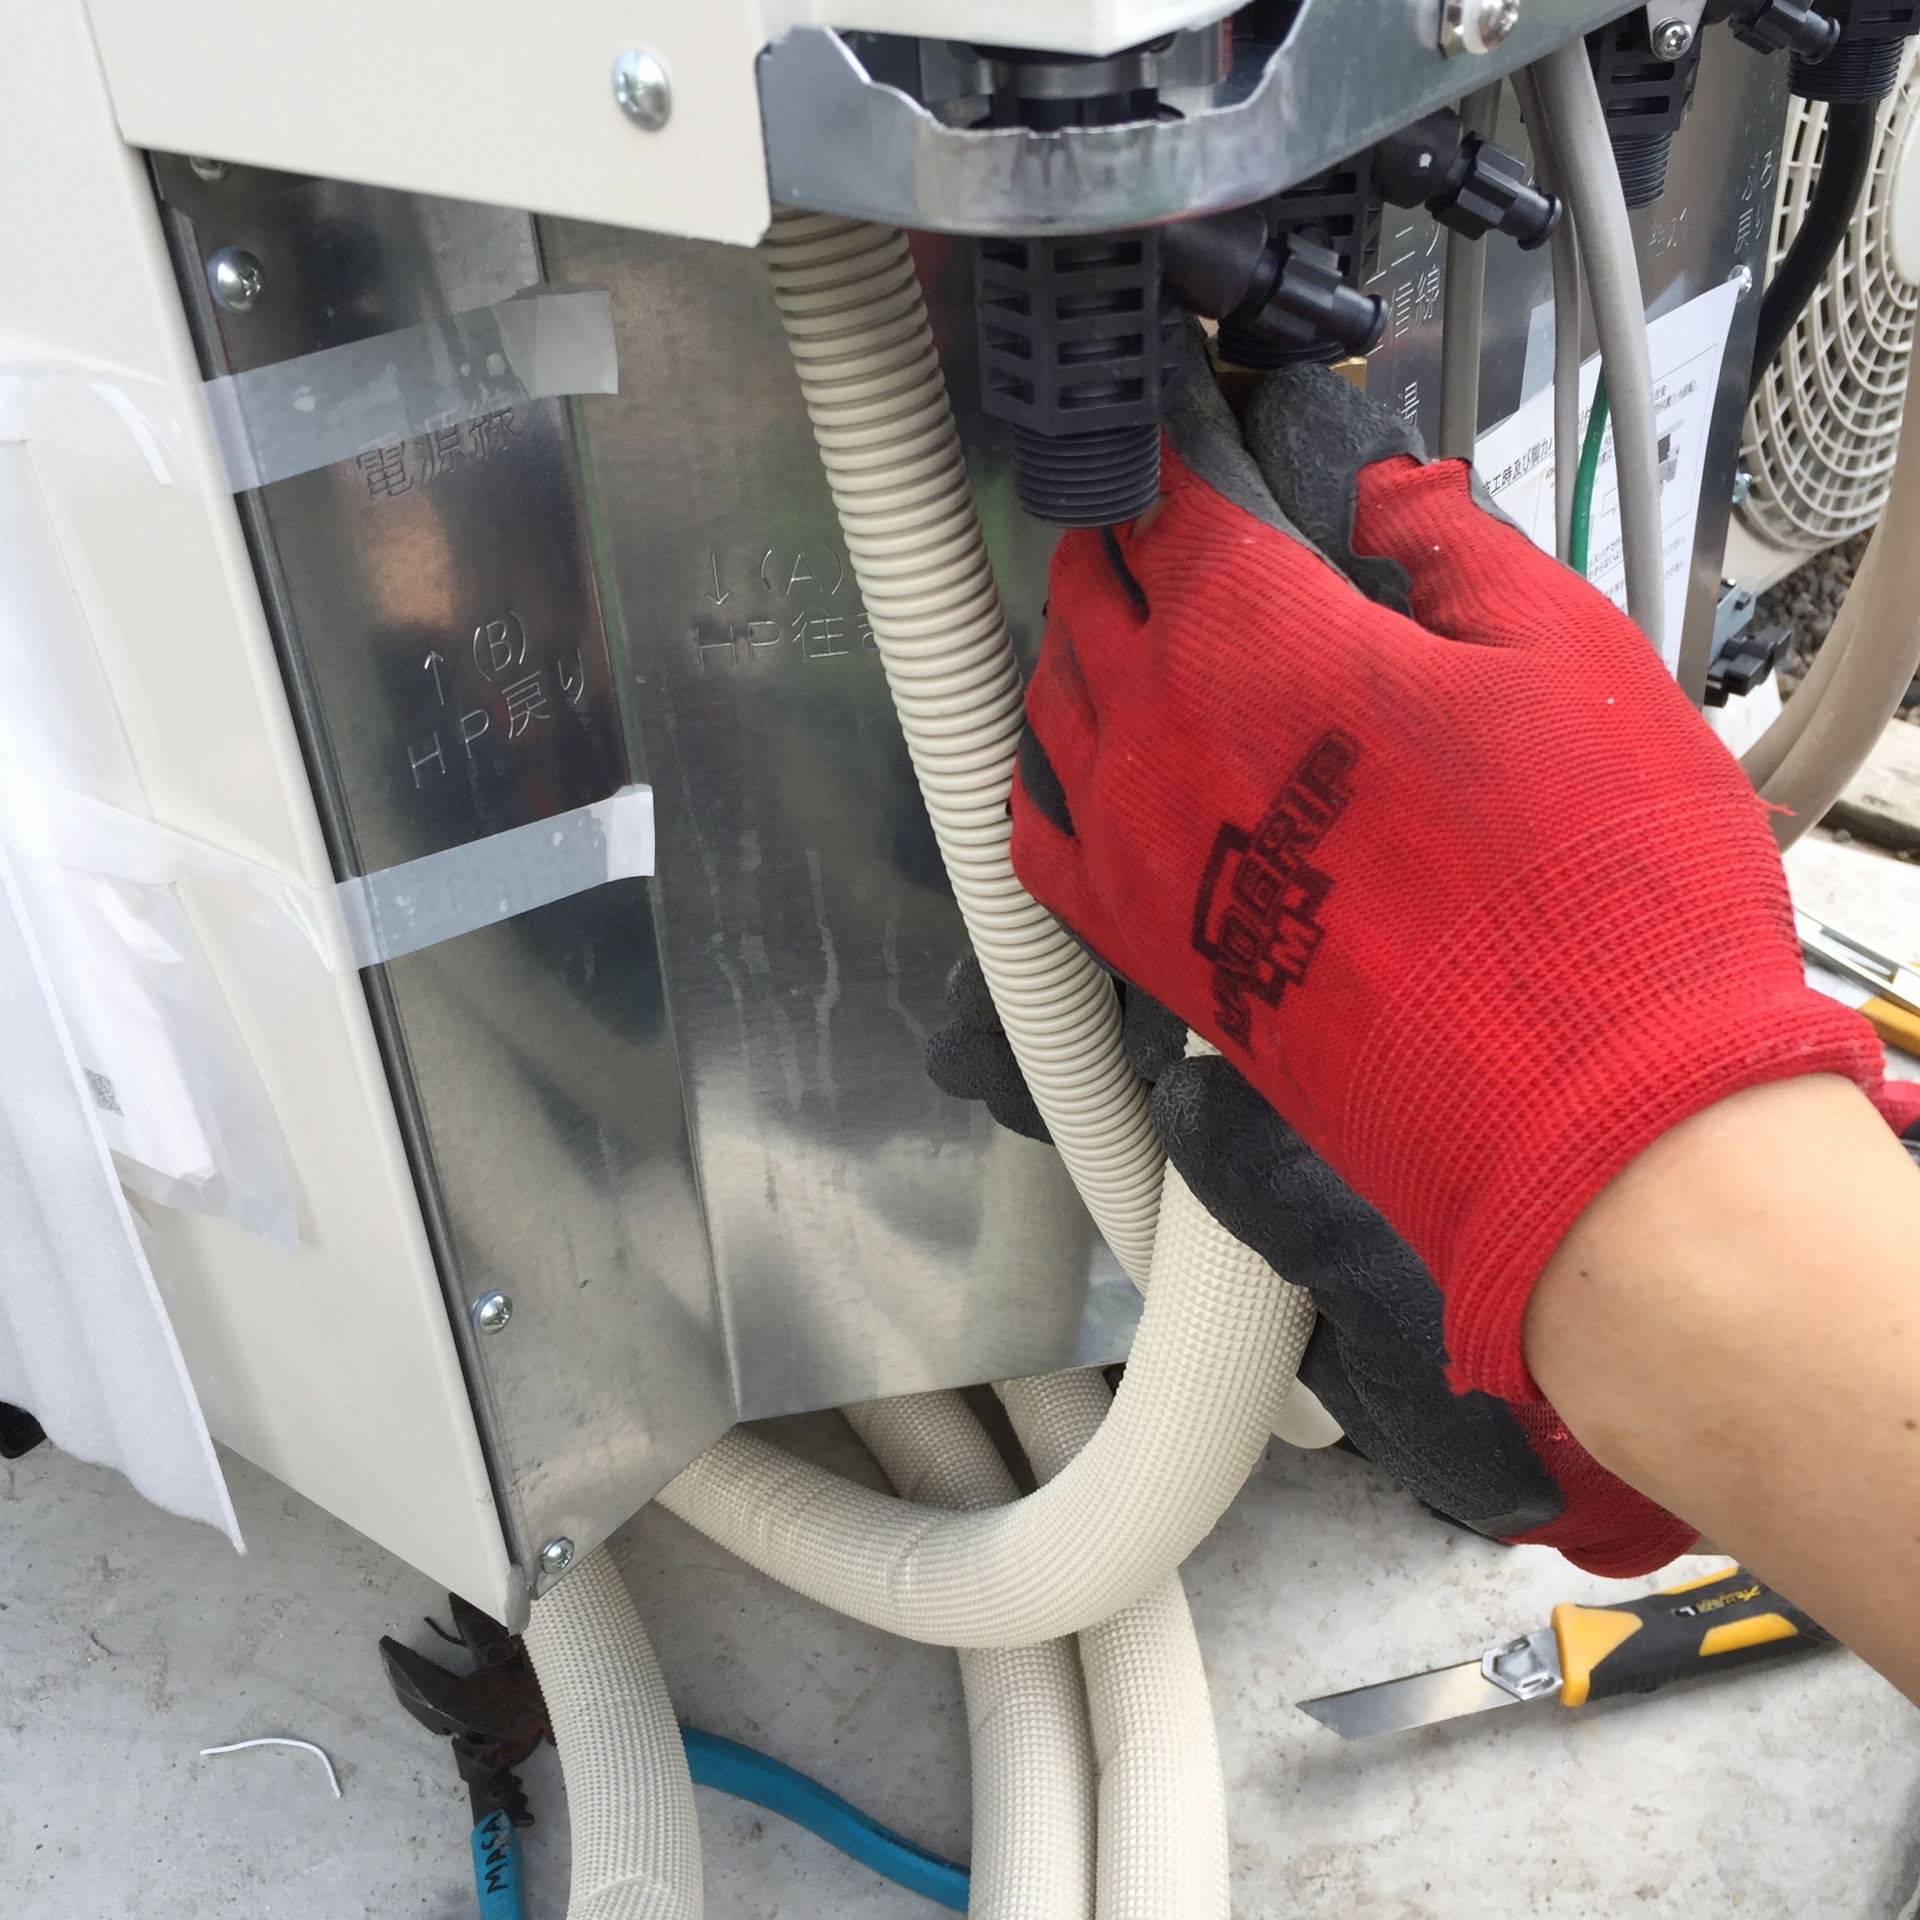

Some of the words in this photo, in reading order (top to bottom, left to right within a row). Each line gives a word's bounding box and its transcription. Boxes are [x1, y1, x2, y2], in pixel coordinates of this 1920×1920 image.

[761, 542, 844, 602] (A)
[472, 610, 527, 682] (B)
[481, 1811, 509, 1895] MASA
